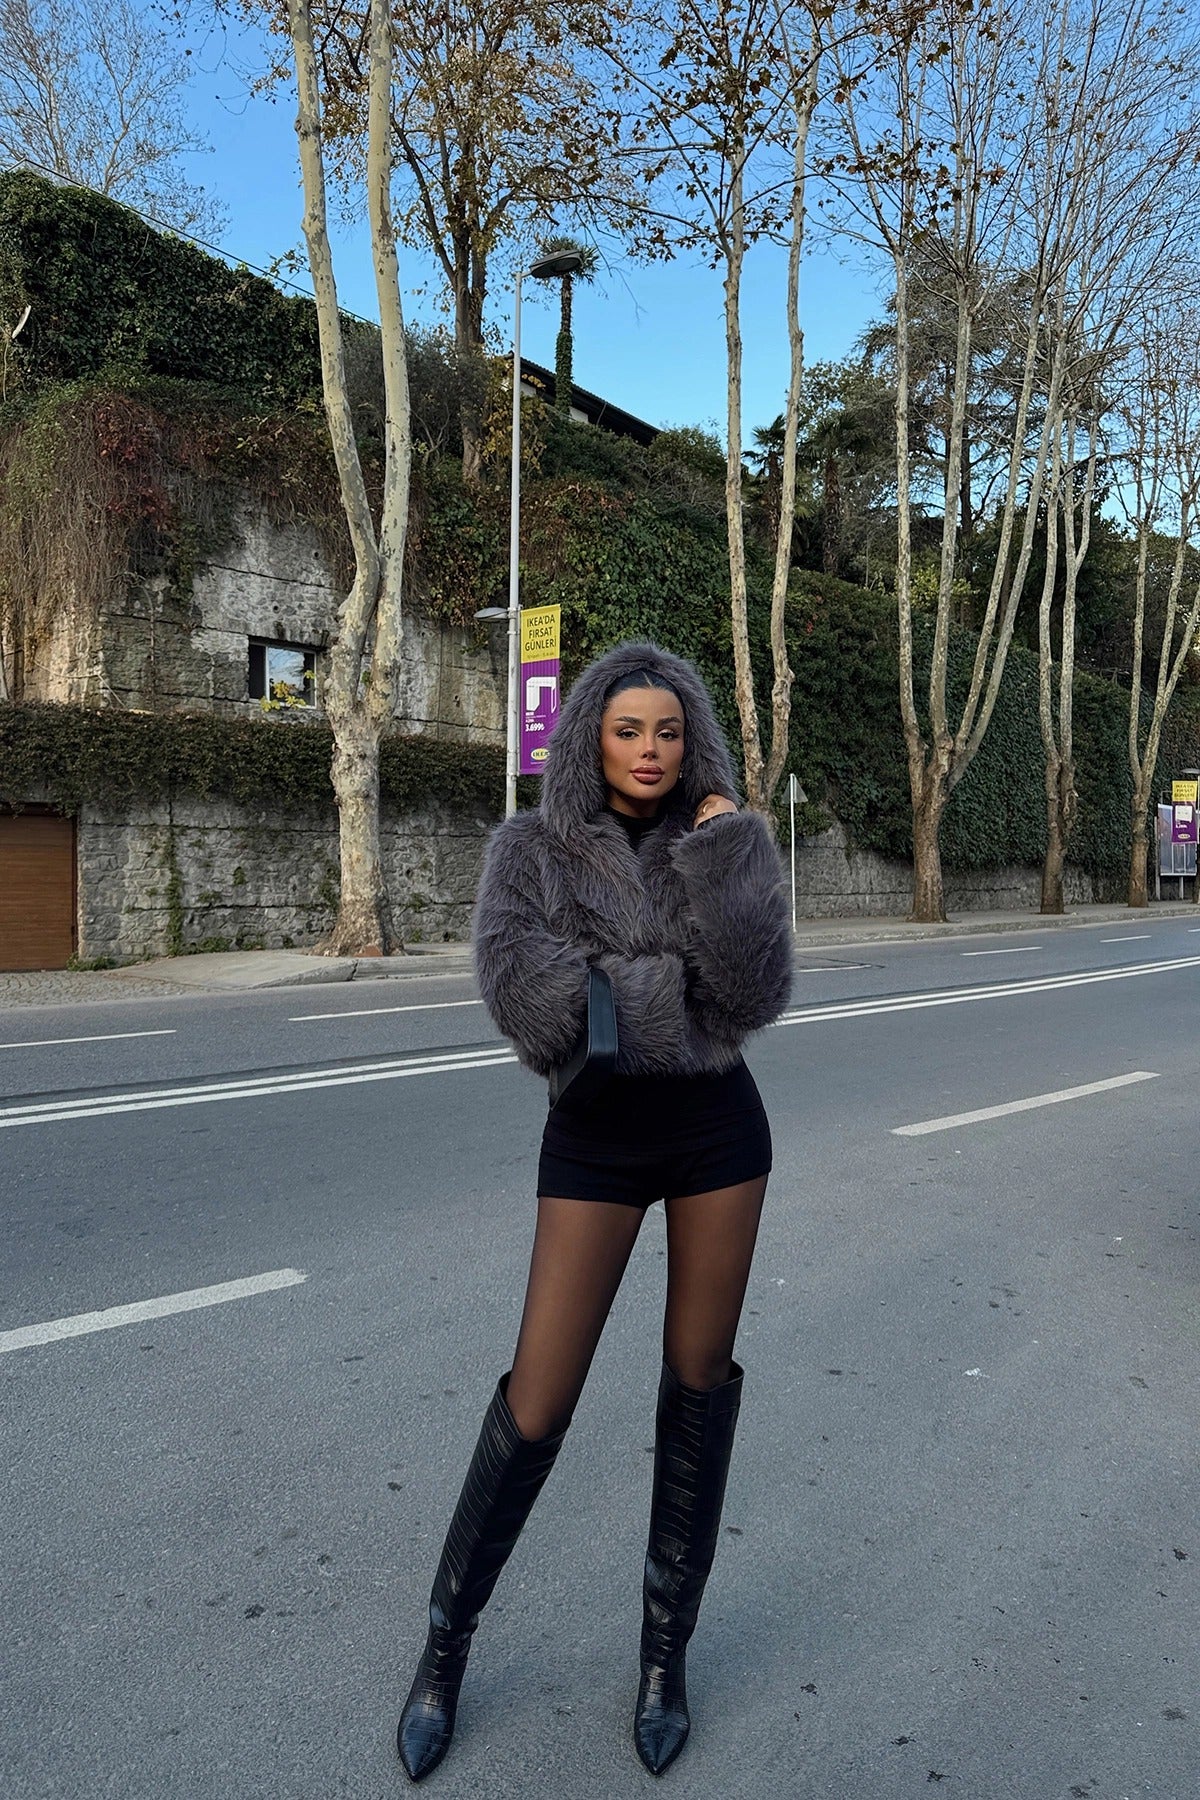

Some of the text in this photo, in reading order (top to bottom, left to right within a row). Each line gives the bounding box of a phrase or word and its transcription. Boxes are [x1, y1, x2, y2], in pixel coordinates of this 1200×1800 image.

[526, 614, 556, 628] IKEA'DA
[528, 627, 553, 639] FIRSAT
[525, 635, 557, 651] GÜNLERİ
